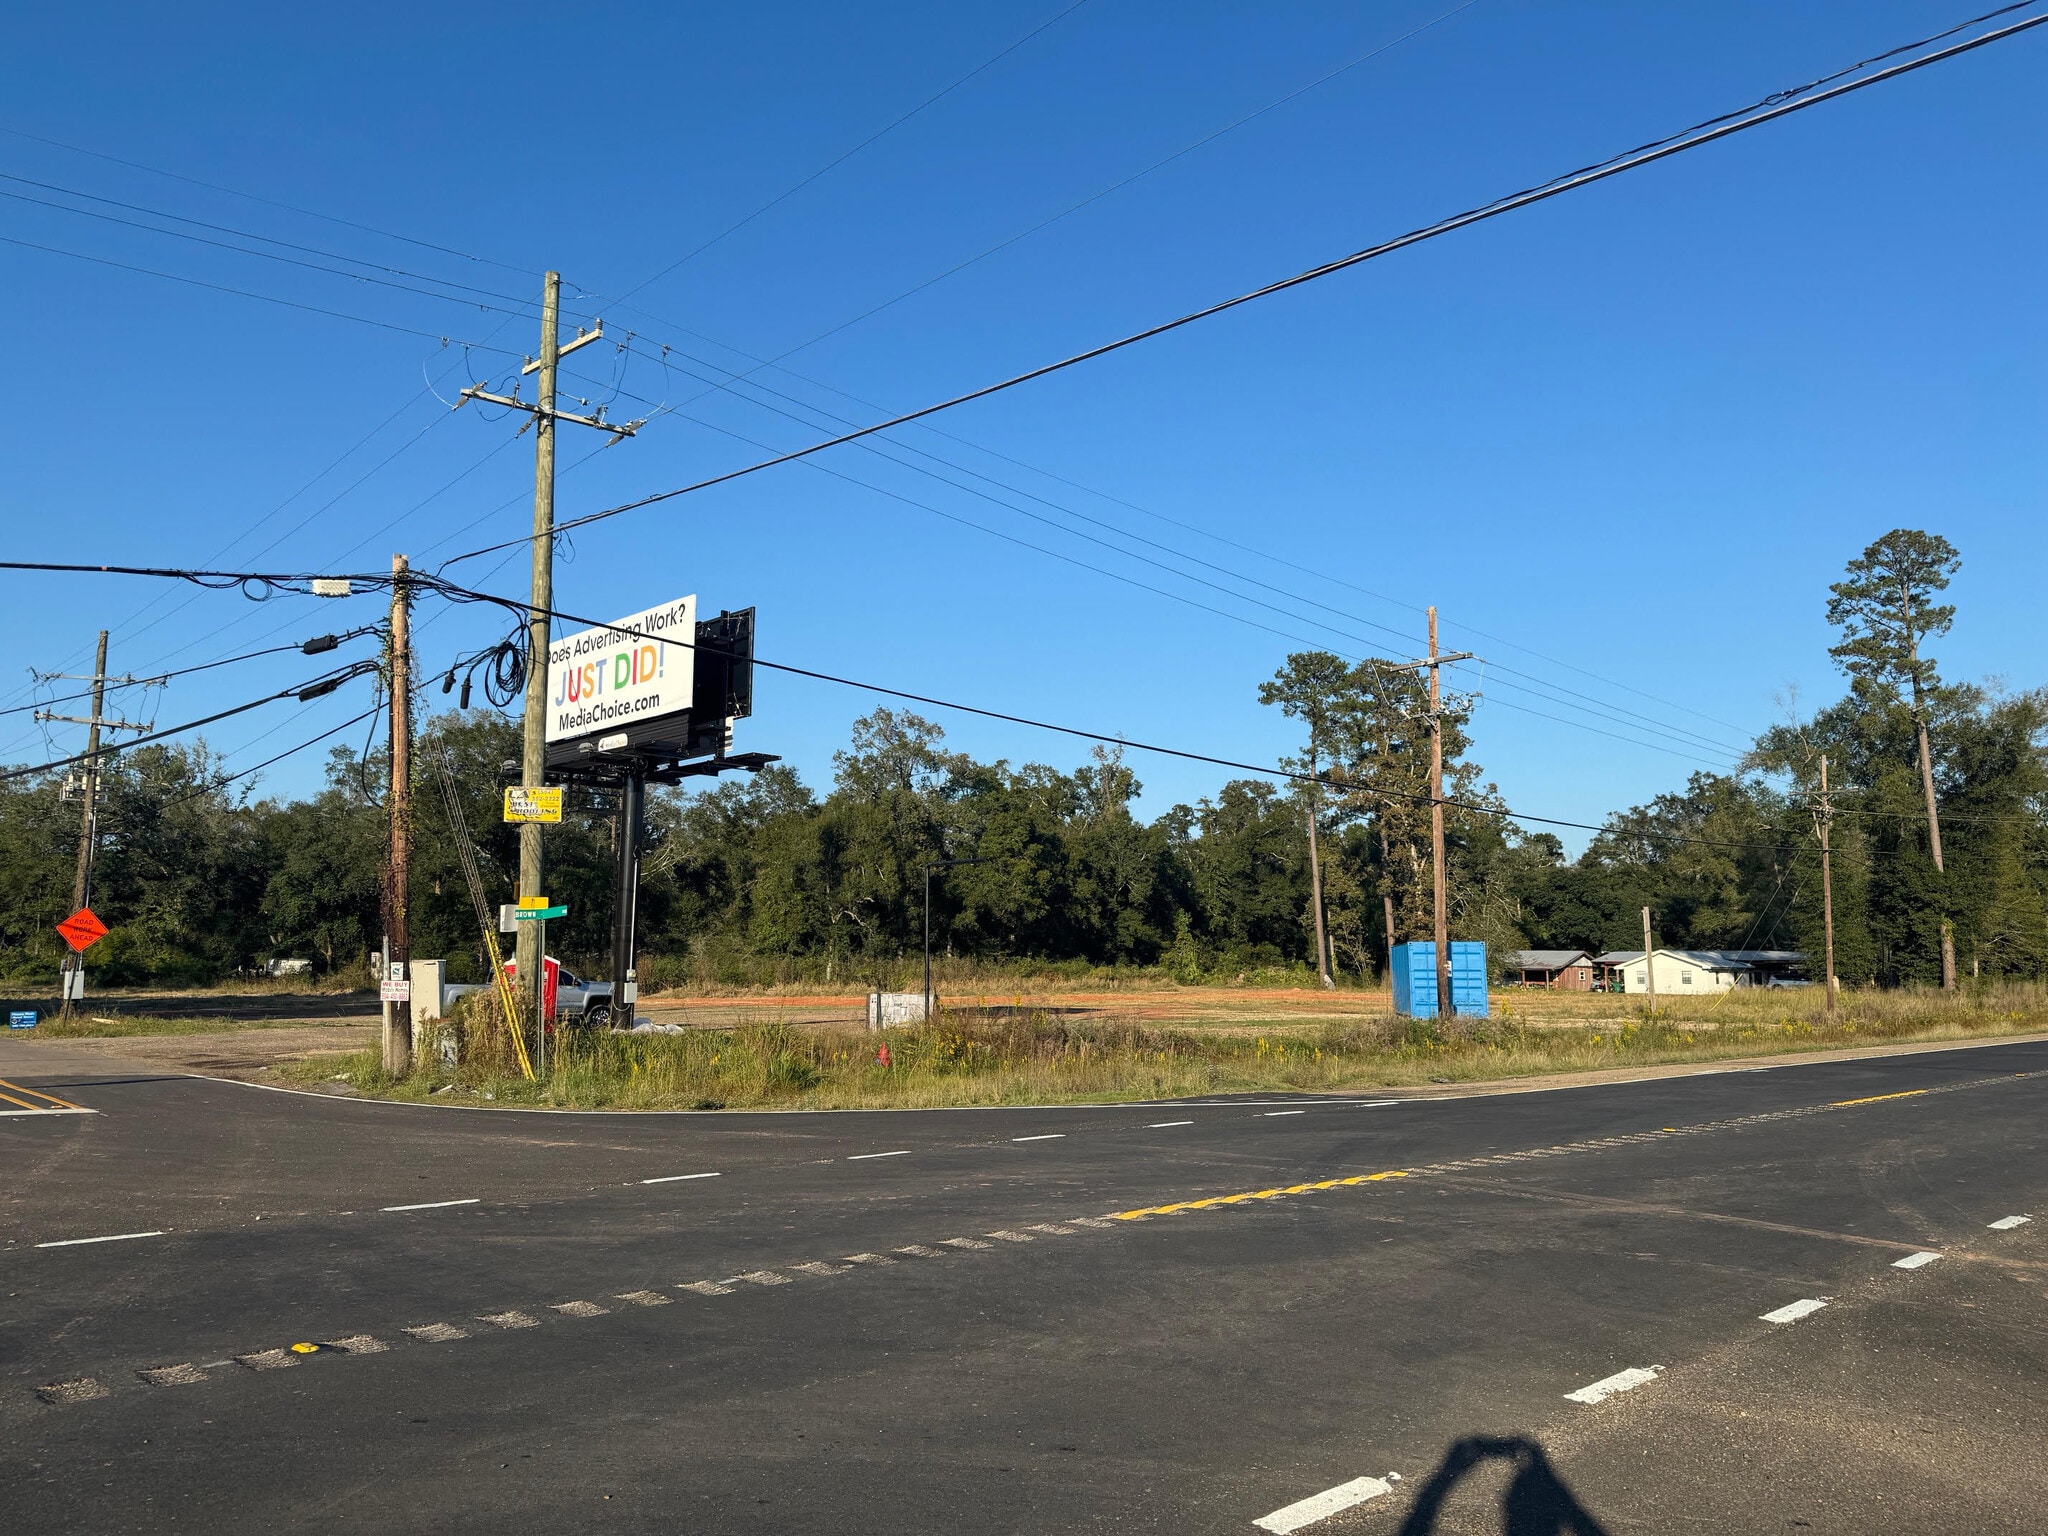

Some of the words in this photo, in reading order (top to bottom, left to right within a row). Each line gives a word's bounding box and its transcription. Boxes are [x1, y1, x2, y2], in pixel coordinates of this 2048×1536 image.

[574, 622, 641, 657] Advertising
[645, 603, 686, 634] Work?
[555, 658, 607, 707] JUST
[614, 642, 665, 691] DID!
[559, 694, 660, 732] MediaChoice.com
[73, 925, 92, 933] WORK
